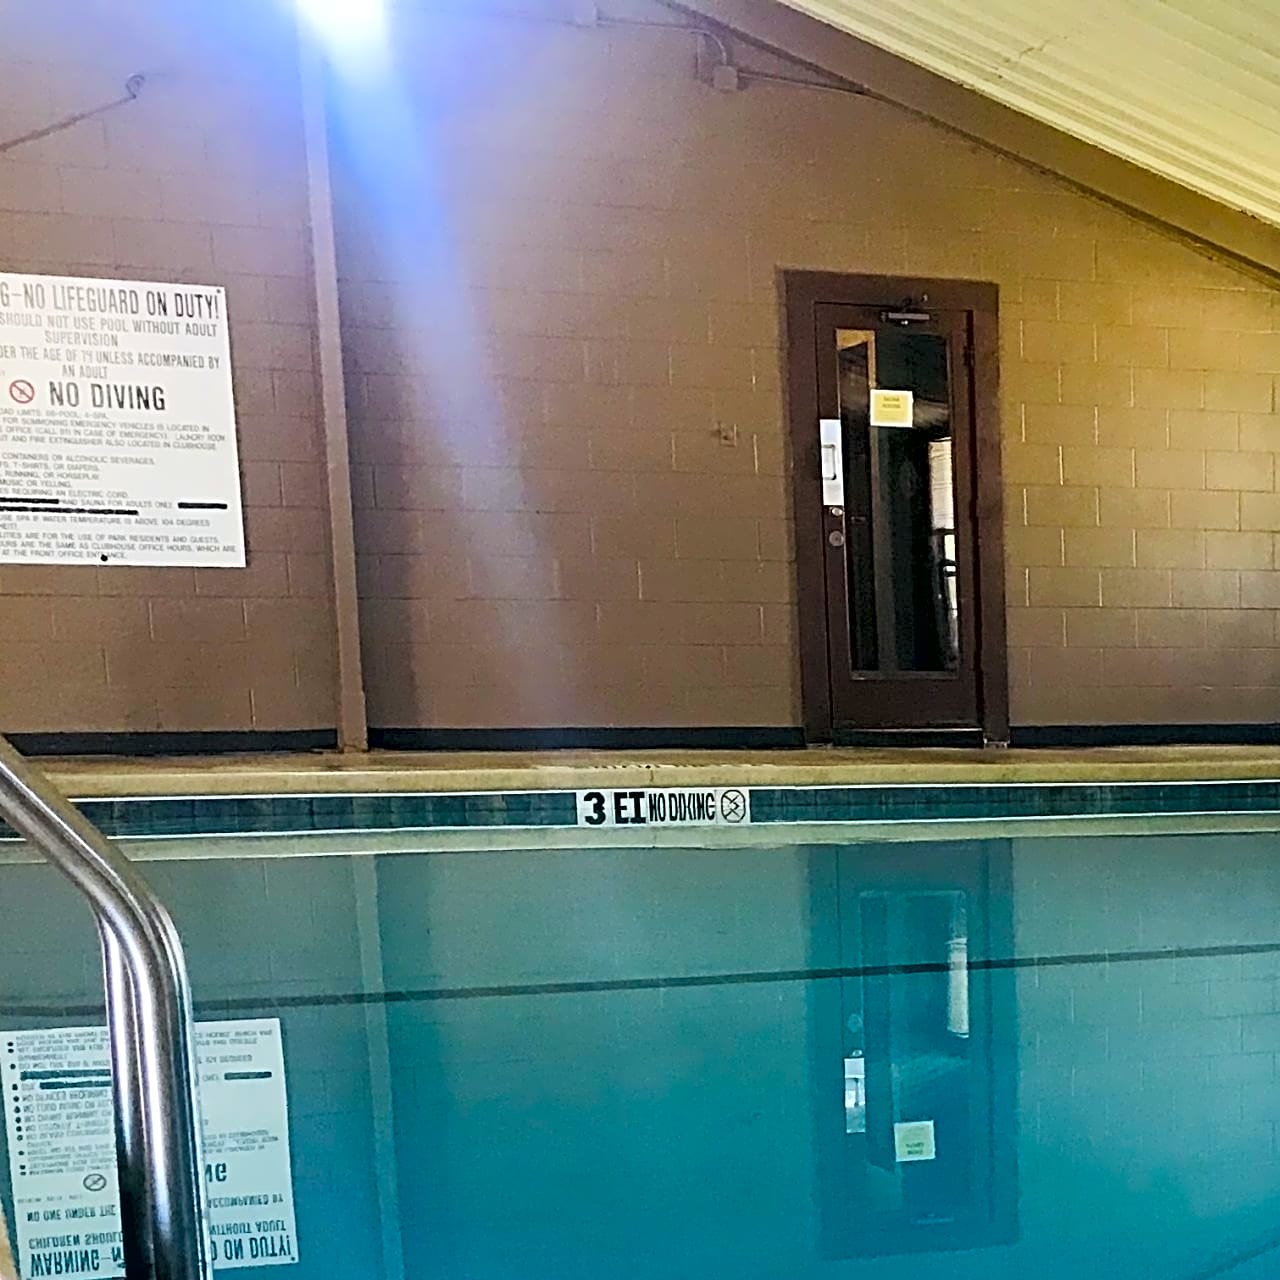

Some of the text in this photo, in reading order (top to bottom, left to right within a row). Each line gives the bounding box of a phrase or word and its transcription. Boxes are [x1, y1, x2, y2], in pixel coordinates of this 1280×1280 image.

[52, 284, 139, 314] LIFEGUARD
[147, 291, 168, 317] ON
[176, 293, 220, 320] DUTY!
[0, 312, 218, 337] SHOULD NOT USE POOL WITHOUT ADULT
[45, 330, 119, 347] SUPERVISION
[20, 346, 39, 360] THE
[43, 348, 62, 361] AGE
[65, 349, 77, 362] OF
[96, 351, 134, 365] UNLESS
[137, 352, 205, 369] ACCOMPANIED
[208, 355, 220, 370] BY
[62, 364, 108, 379] AN ADULT
[49, 381, 166, 411] NO DIVING
[70, 420, 116, 429] EMERGENCY
[119, 422, 155, 431] VEHICLES
[167, 424, 199, 432] LOCATED
[84, 429, 103, 437] CASE
[48, 437, 102, 446] EXTINGUISHER
[106, 439, 125, 447] ALSO
[128, 441, 160, 449] LOCATED
[1, 452, 48, 461] CONTAINERS
[66, 455, 108, 463] ALCOHOLIC
[68, 490, 103, 498] ELECTRIC
[176, 519, 210, 527] DEGREES
[129, 535, 169, 543] RESIDENTS
[30, 550, 54, 558] FRONT
[57, 551, 83, 559] OFFICE
[139, 544, 163, 552] OFFICE
[196, 545, 220, 553] WHICH
[584, 791, 606, 825] 3
